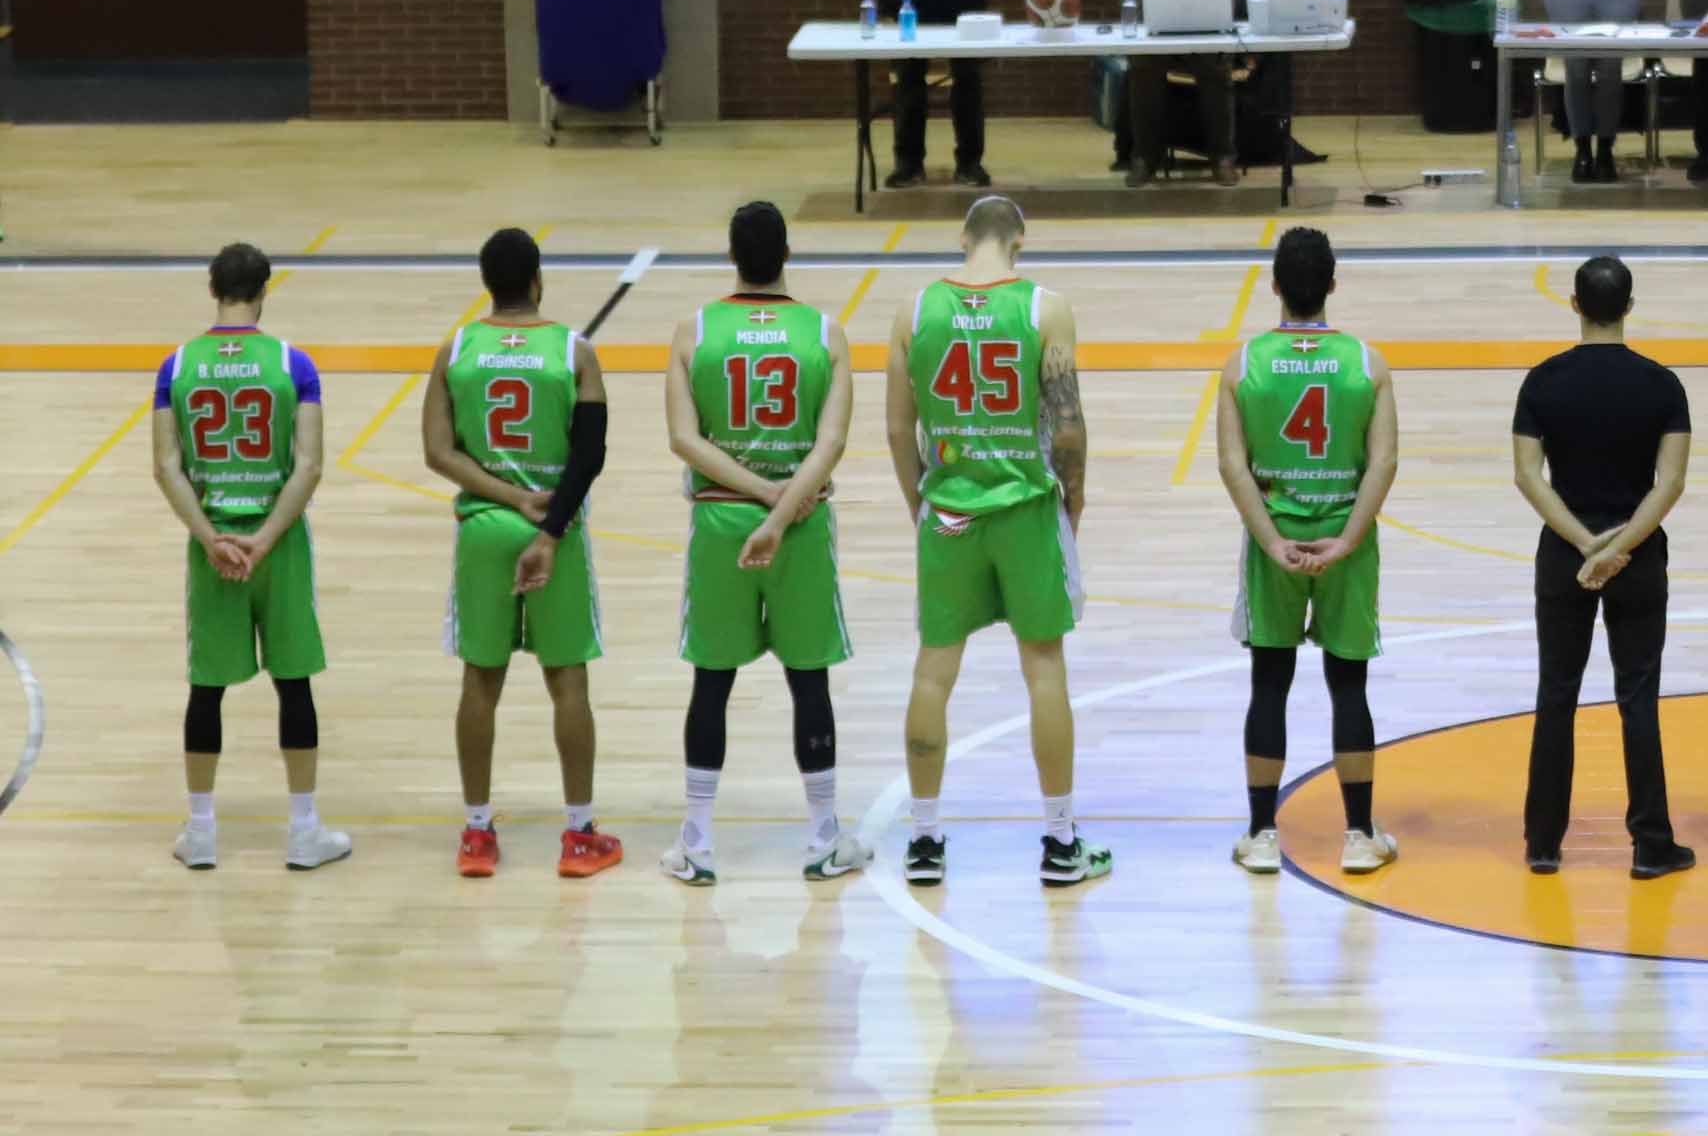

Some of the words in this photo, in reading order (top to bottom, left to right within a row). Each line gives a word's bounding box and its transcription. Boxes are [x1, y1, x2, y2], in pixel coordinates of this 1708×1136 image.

[736, 329, 788, 345] MENDIA
[952, 314, 994, 330] ORLOV
[197, 363, 210, 378] B.
[476, 353, 545, 369] ROBINSON
[929, 339, 1022, 416] 45
[1270, 359, 1339, 374] ESTALAYO
[485, 376, 533, 452] 2
[724, 353, 800, 431] 13
[186, 385, 276, 462] 23
[1279, 383, 1331, 460] 4
